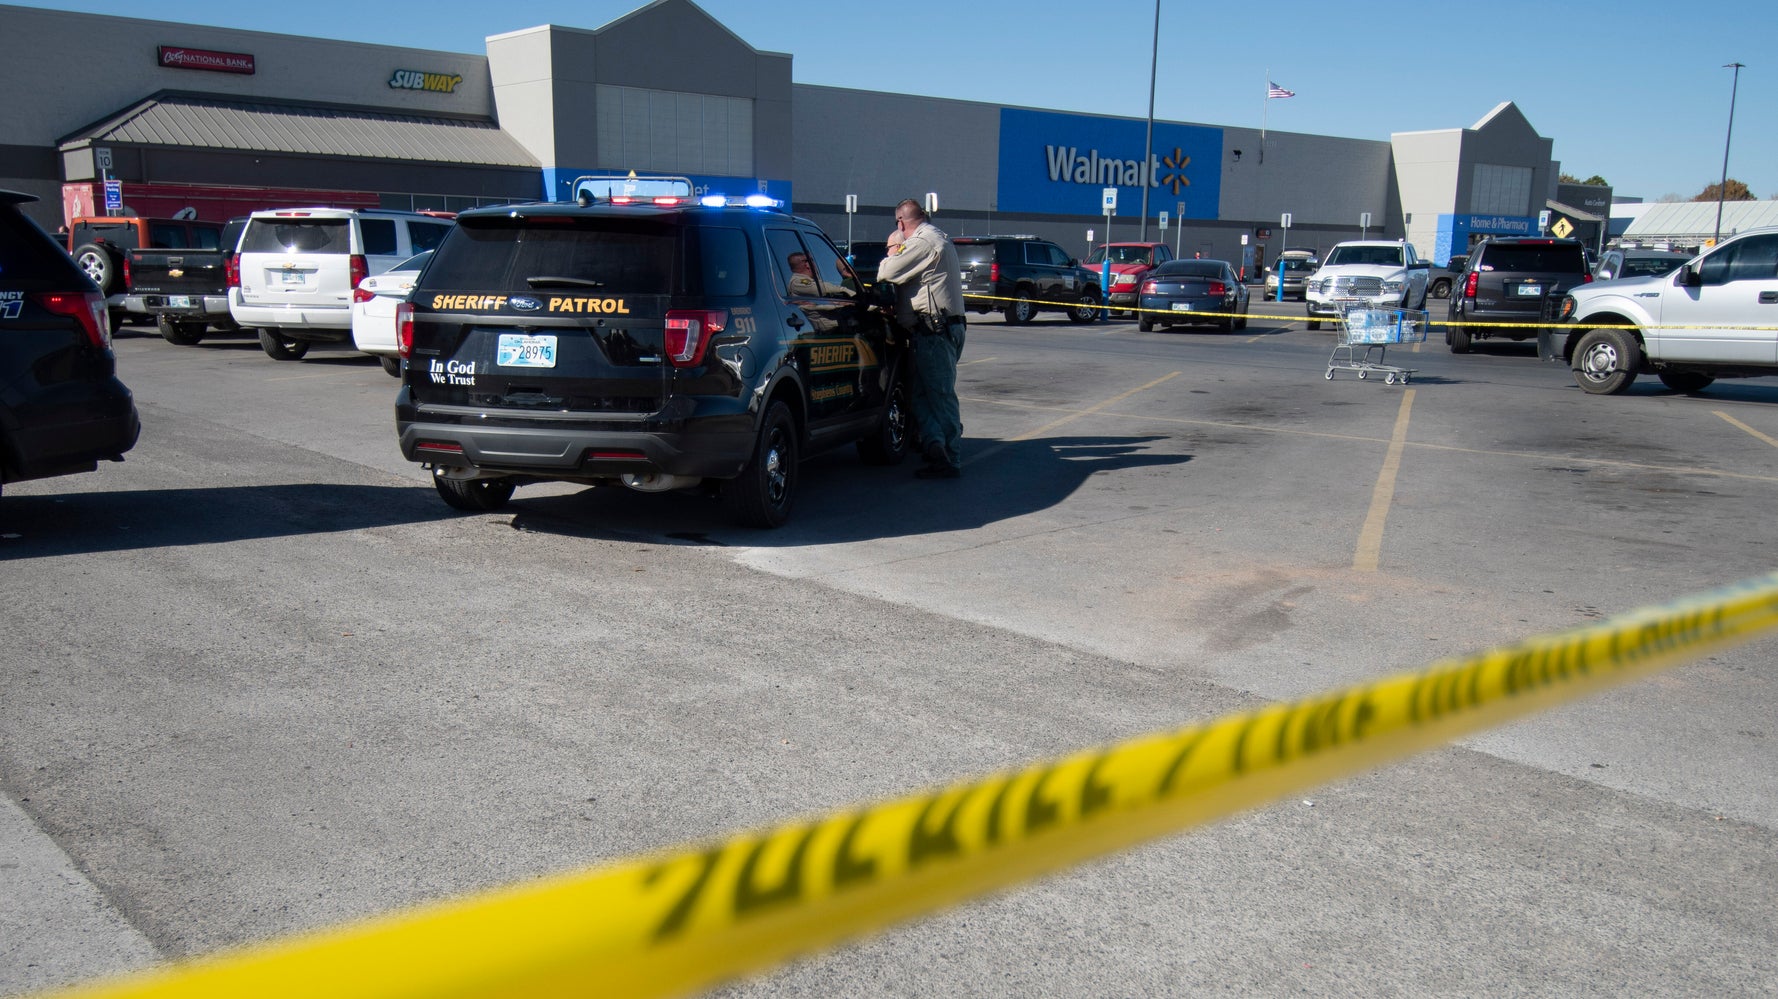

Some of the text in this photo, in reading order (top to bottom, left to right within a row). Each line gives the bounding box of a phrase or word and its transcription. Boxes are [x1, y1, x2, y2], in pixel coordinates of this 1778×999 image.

[164, 50, 248, 69] City NATIONAL BANK
[390, 70, 462, 92] SUBWAY
[100, 156, 111, 166] 10
[1047, 145, 1160, 187] Walmart
[1470, 216, 1529, 232] Home & Pharmacy
[432, 294, 630, 314] SHERIFF PATROL
[735, 316, 756, 334] 911
[518, 345, 552, 361] 28975
[810, 344, 854, 365] SHERIFF
[430, 359, 476, 375] In God
[430, 372, 475, 386] We Trust
